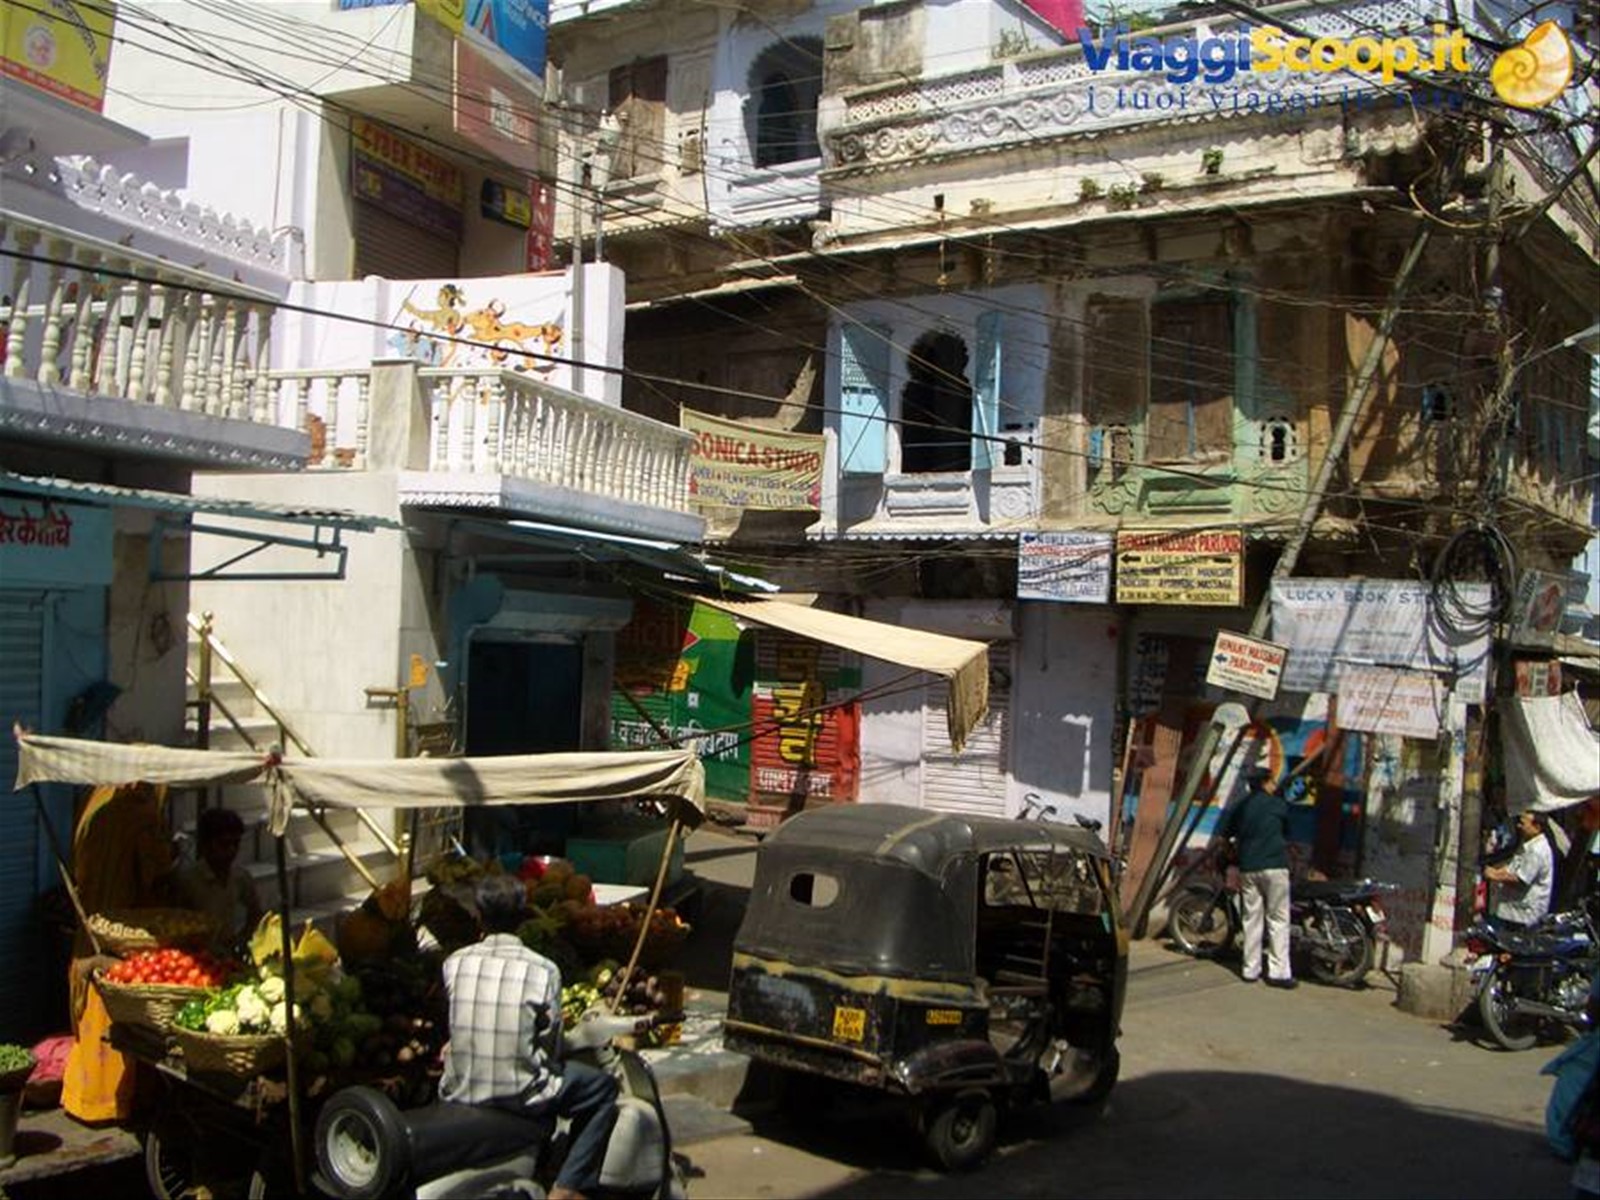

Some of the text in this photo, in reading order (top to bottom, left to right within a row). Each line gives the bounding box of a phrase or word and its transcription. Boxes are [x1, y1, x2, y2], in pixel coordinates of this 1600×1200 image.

[689, 430, 758, 465] SONICA
[1287, 589, 1336, 601] LUCKY
[1344, 590, 1388, 603] BOOK
